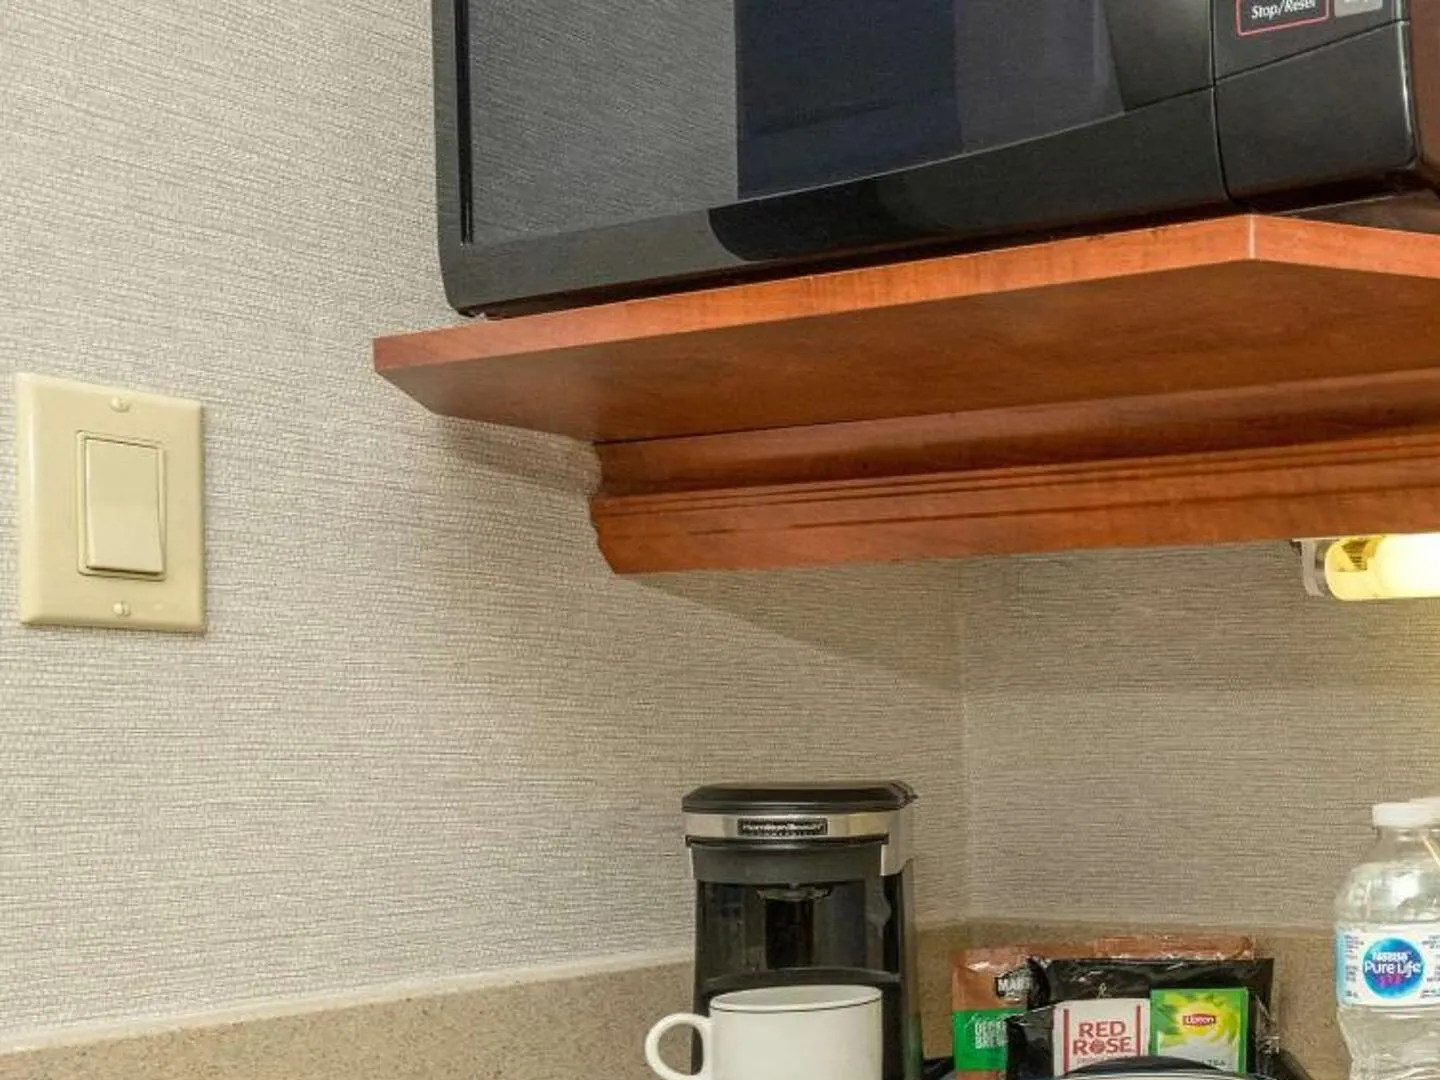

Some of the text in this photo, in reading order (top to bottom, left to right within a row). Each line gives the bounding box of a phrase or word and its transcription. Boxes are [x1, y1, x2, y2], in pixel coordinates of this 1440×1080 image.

[1365, 961, 1395, 974] Pure
[1397, 961, 1421, 978] Life
[1079, 1021, 1125, 1038] RED
[1073, 1037, 1131, 1054] ROSE
